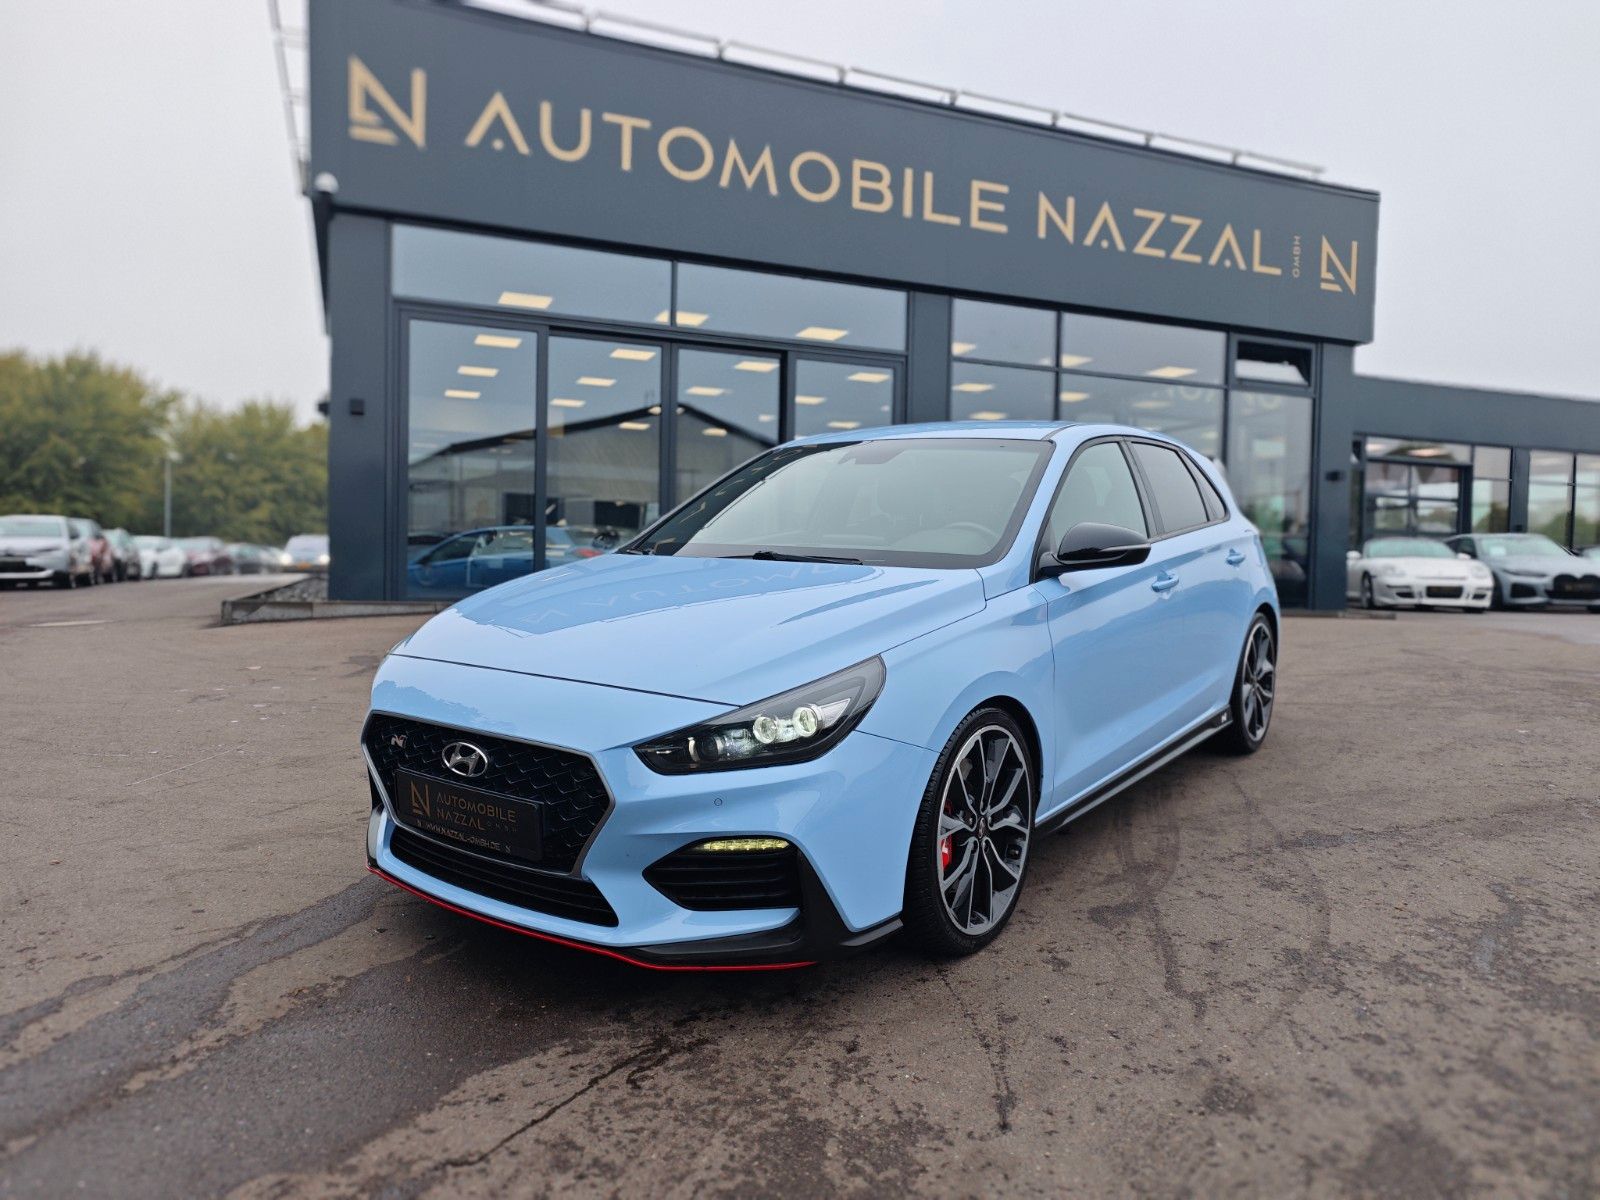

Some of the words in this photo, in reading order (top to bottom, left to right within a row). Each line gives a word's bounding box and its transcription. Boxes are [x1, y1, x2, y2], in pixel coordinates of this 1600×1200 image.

[466, 92, 1010, 234] AUTOMOBILE
[1037, 191, 1282, 277] NAZZAL
[437, 792, 516, 823] AUTOMOBILE
[437, 808, 486, 831] NAZZAL
